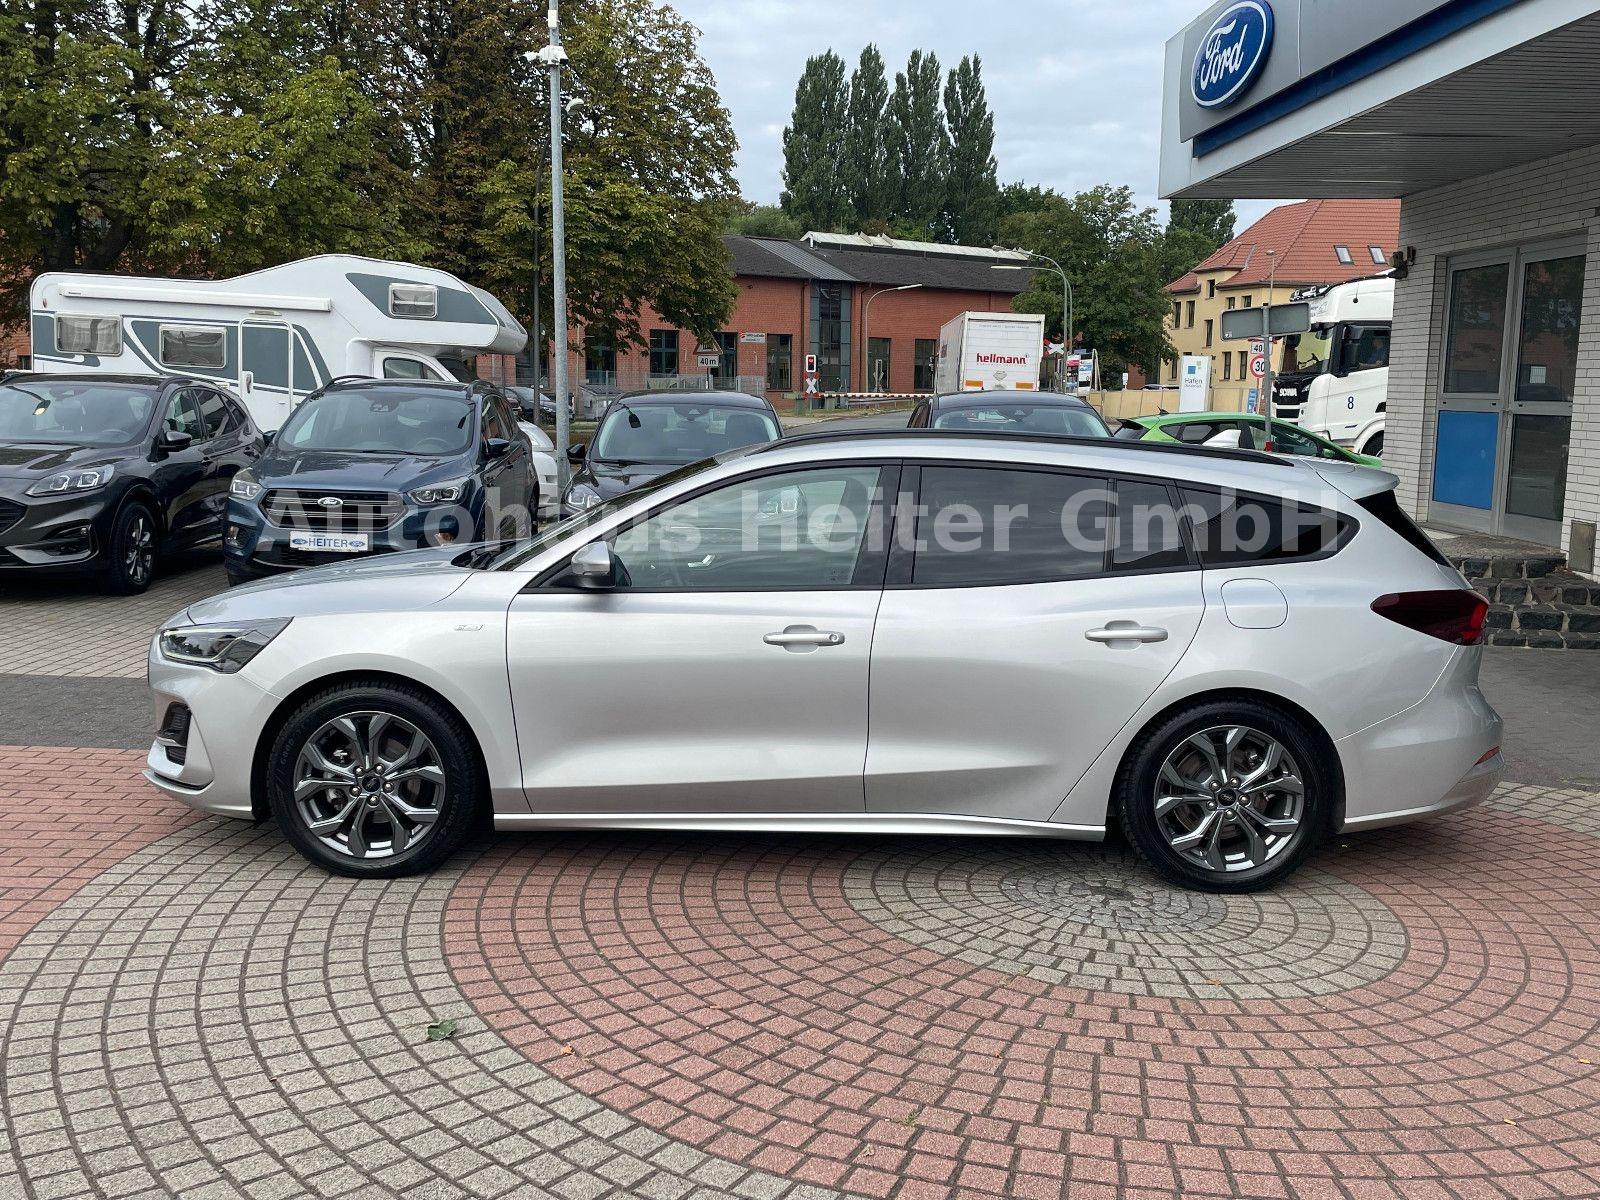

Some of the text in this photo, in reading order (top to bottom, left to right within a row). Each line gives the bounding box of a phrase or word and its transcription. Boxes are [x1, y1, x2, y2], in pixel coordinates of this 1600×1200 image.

[1200, 19, 1248, 90] Ford
[1253, 344, 1263, 352] 40
[700, 357, 709, 366] 40
[976, 353, 1027, 365] hellmann
[1255, 361, 1265, 372] 30
[1184, 377, 1203, 385] Hafen
[1347, 396, 1355, 410] 8
[309, 538, 348, 548] HEITER
